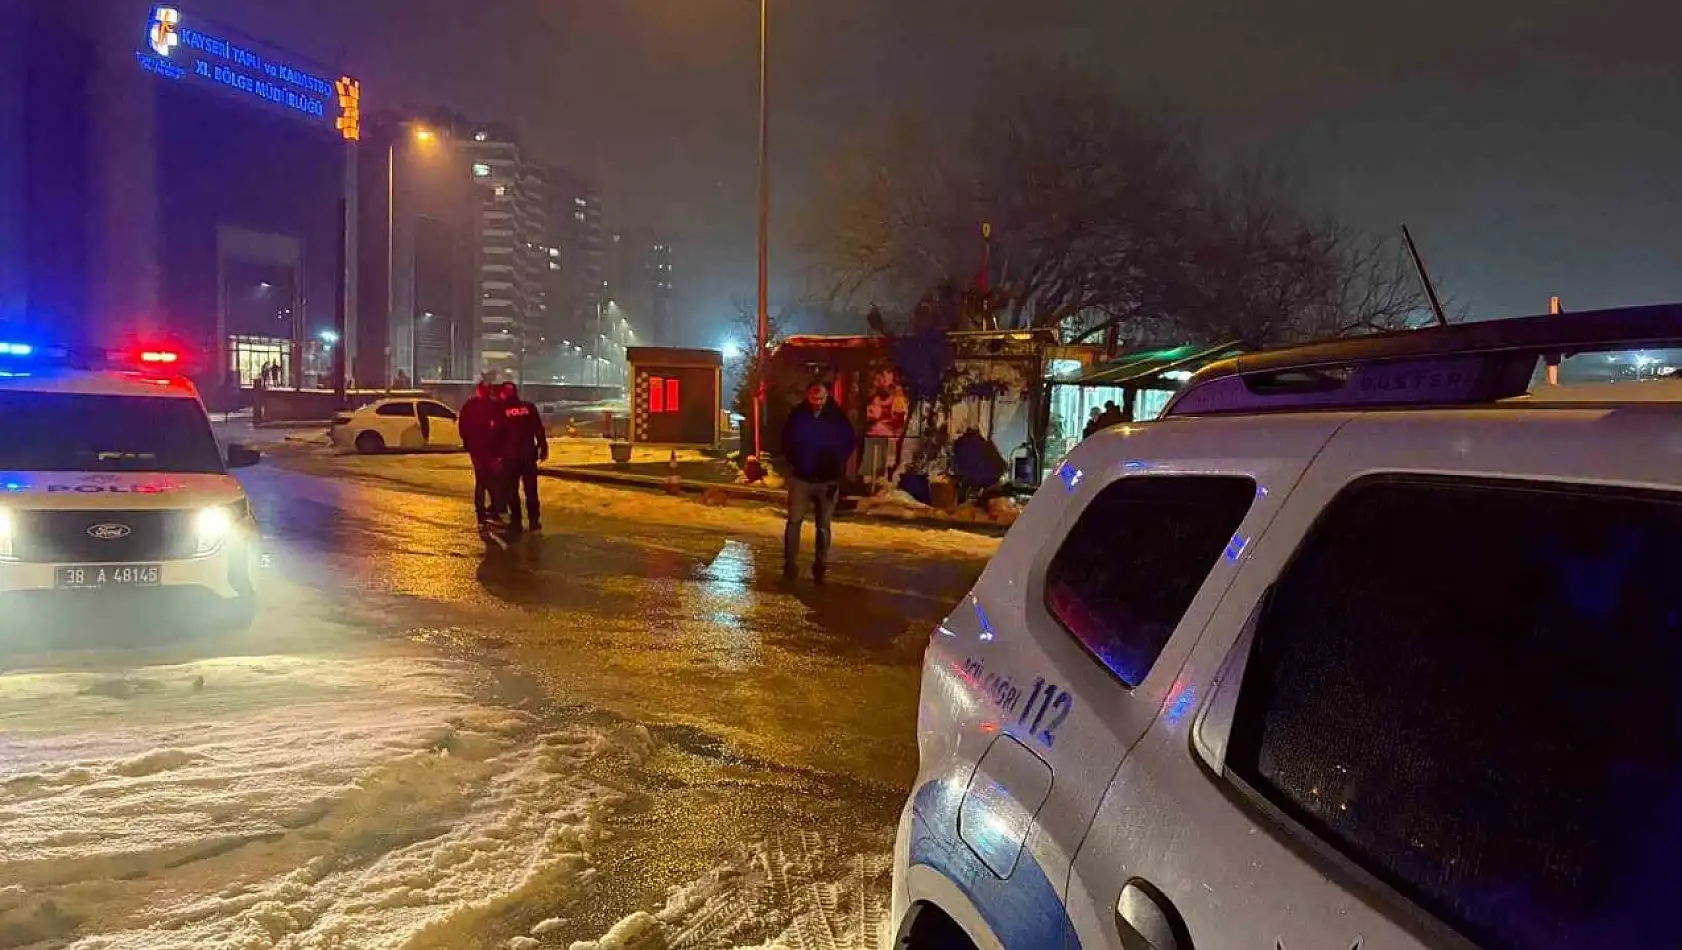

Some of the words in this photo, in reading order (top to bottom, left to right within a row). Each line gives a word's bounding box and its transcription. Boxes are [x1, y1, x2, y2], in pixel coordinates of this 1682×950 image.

[181, 28, 230, 60] KAYSERİ
[232, 48, 261, 69] TAPU
[279, 66, 333, 97] KADASTRO
[215, 65, 252, 92] BÖLGE
[1361, 371, 1464, 392] DUSTER
[95, 525, 124, 537] Ford
[66, 568, 84, 583] 38
[97, 569, 107, 583] A
[114, 567, 158, 583] 48145
[1018, 676, 1074, 748] 112
